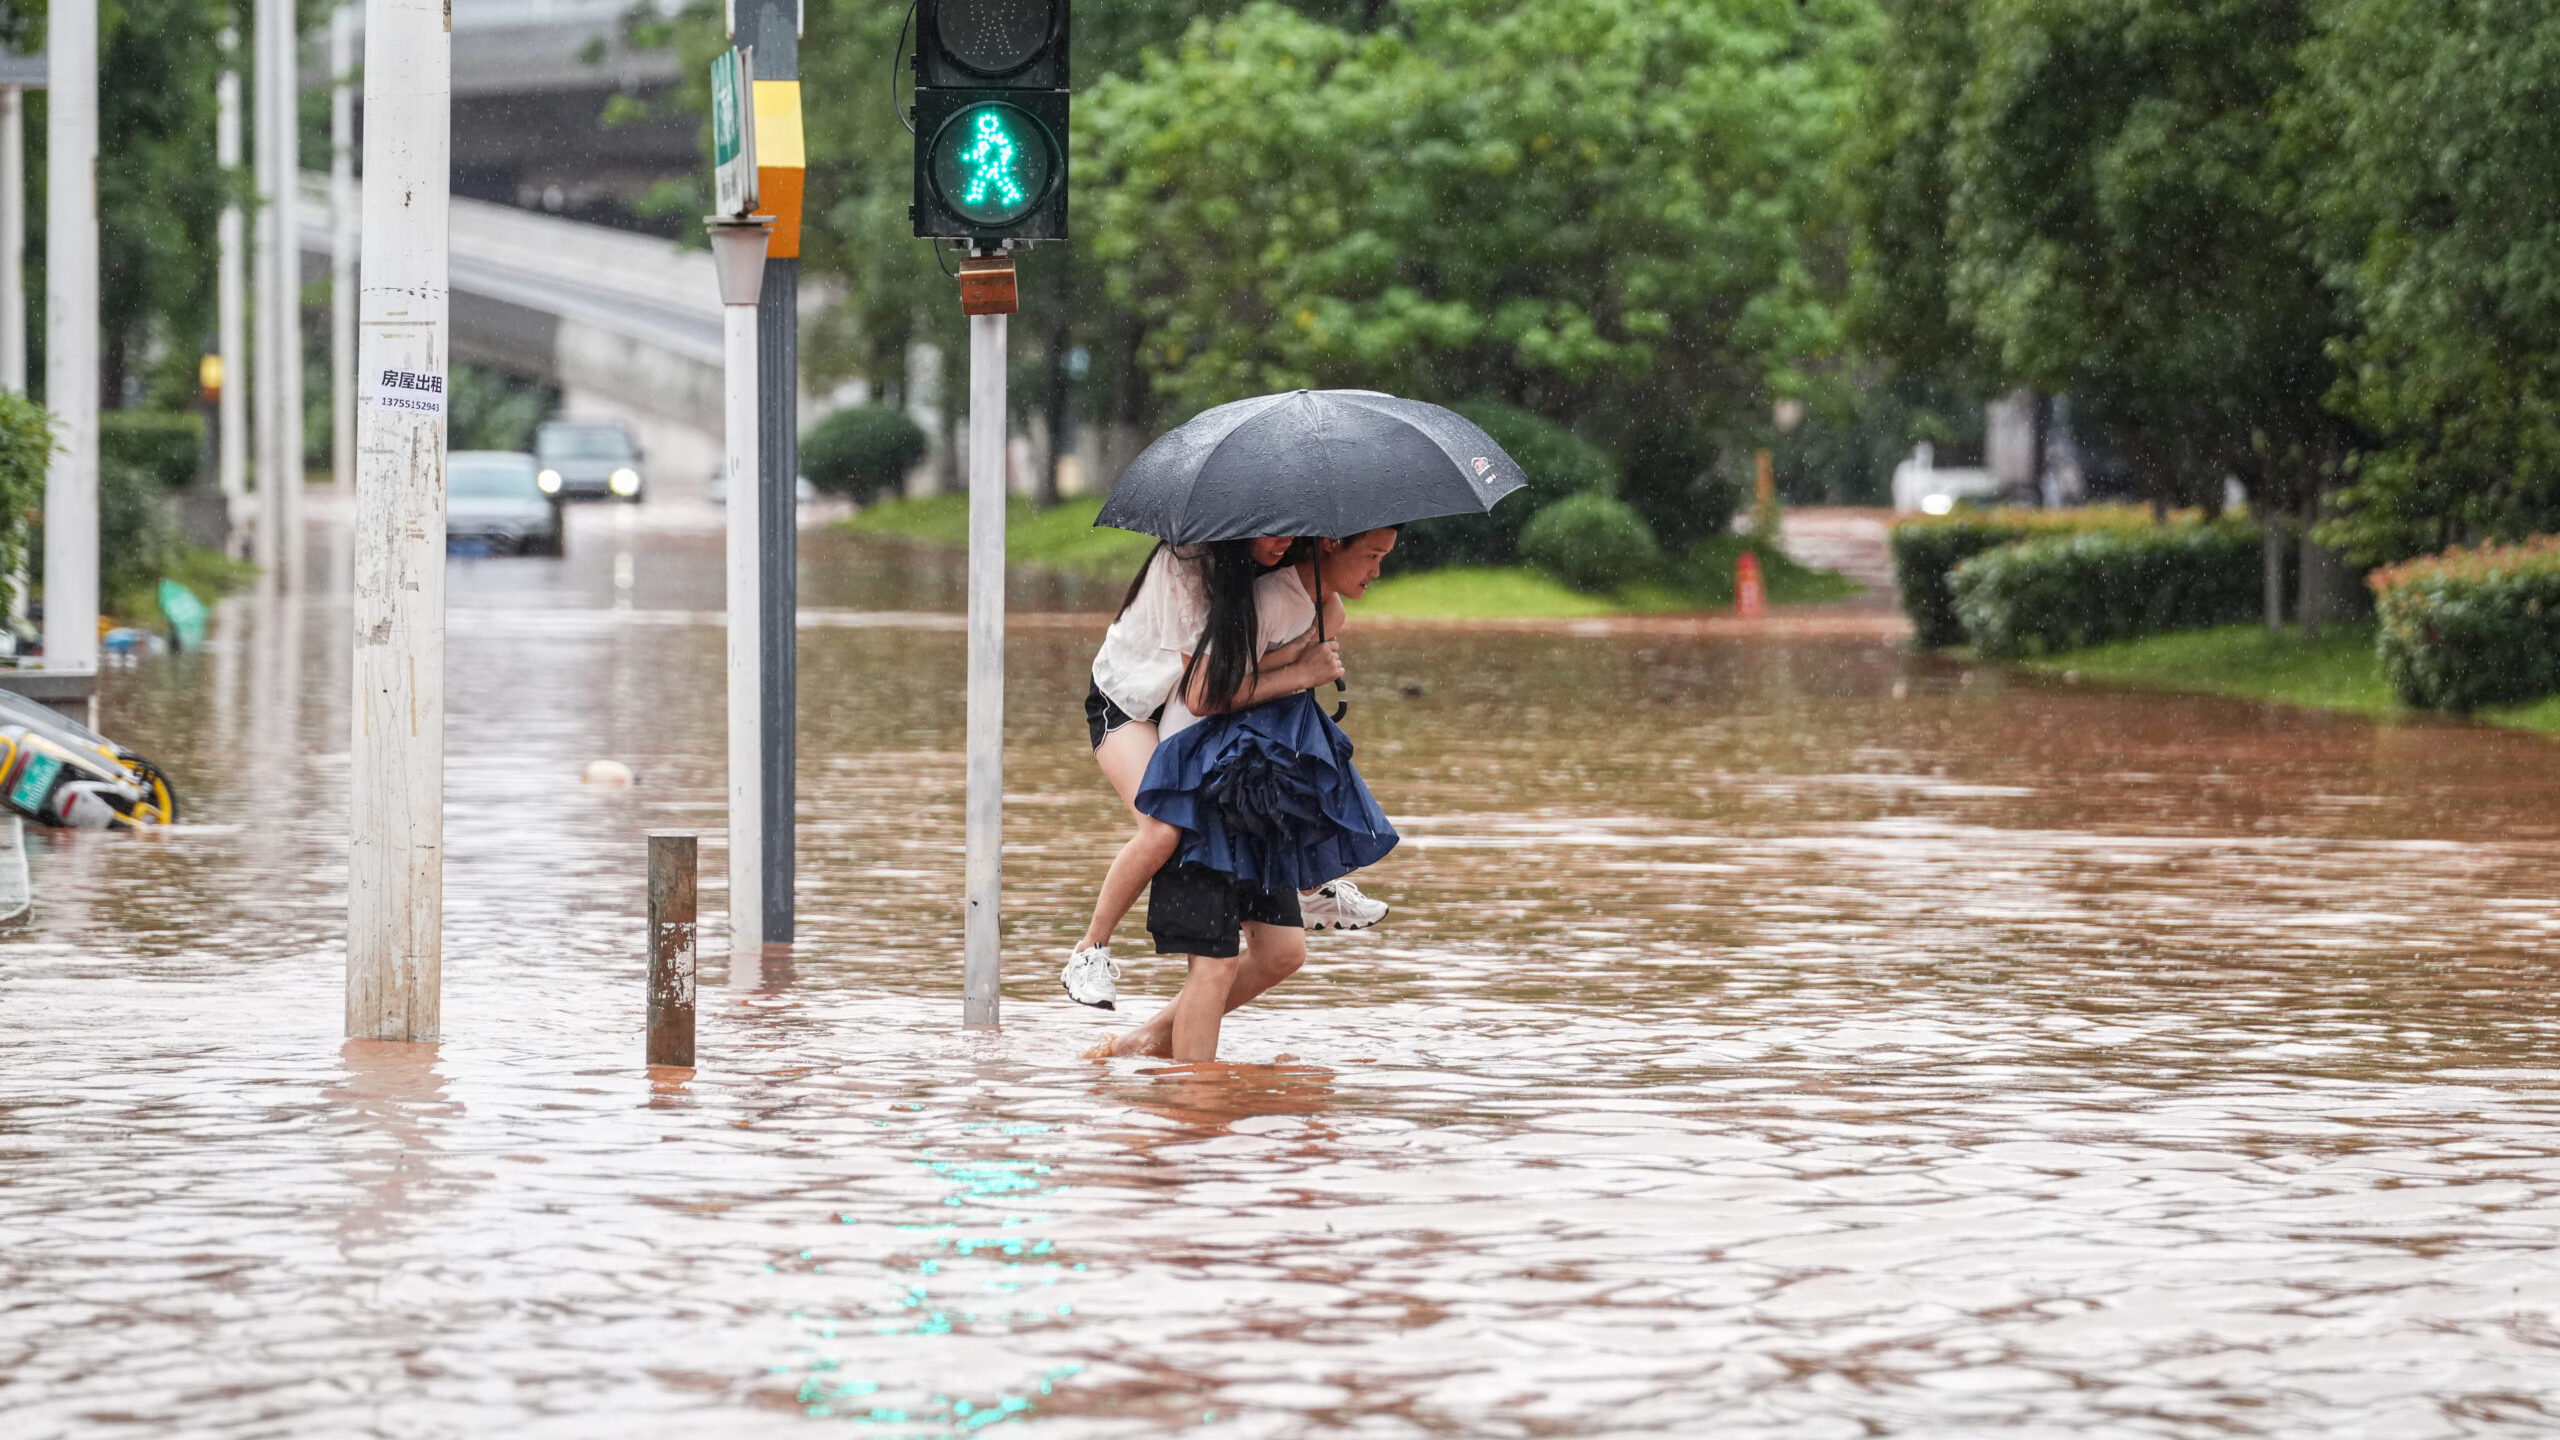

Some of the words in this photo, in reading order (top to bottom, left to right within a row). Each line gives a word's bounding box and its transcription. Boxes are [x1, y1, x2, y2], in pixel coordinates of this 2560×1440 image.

[381, 370, 442, 393] 房屋出租
[381, 397, 440, 412] 13755152943
